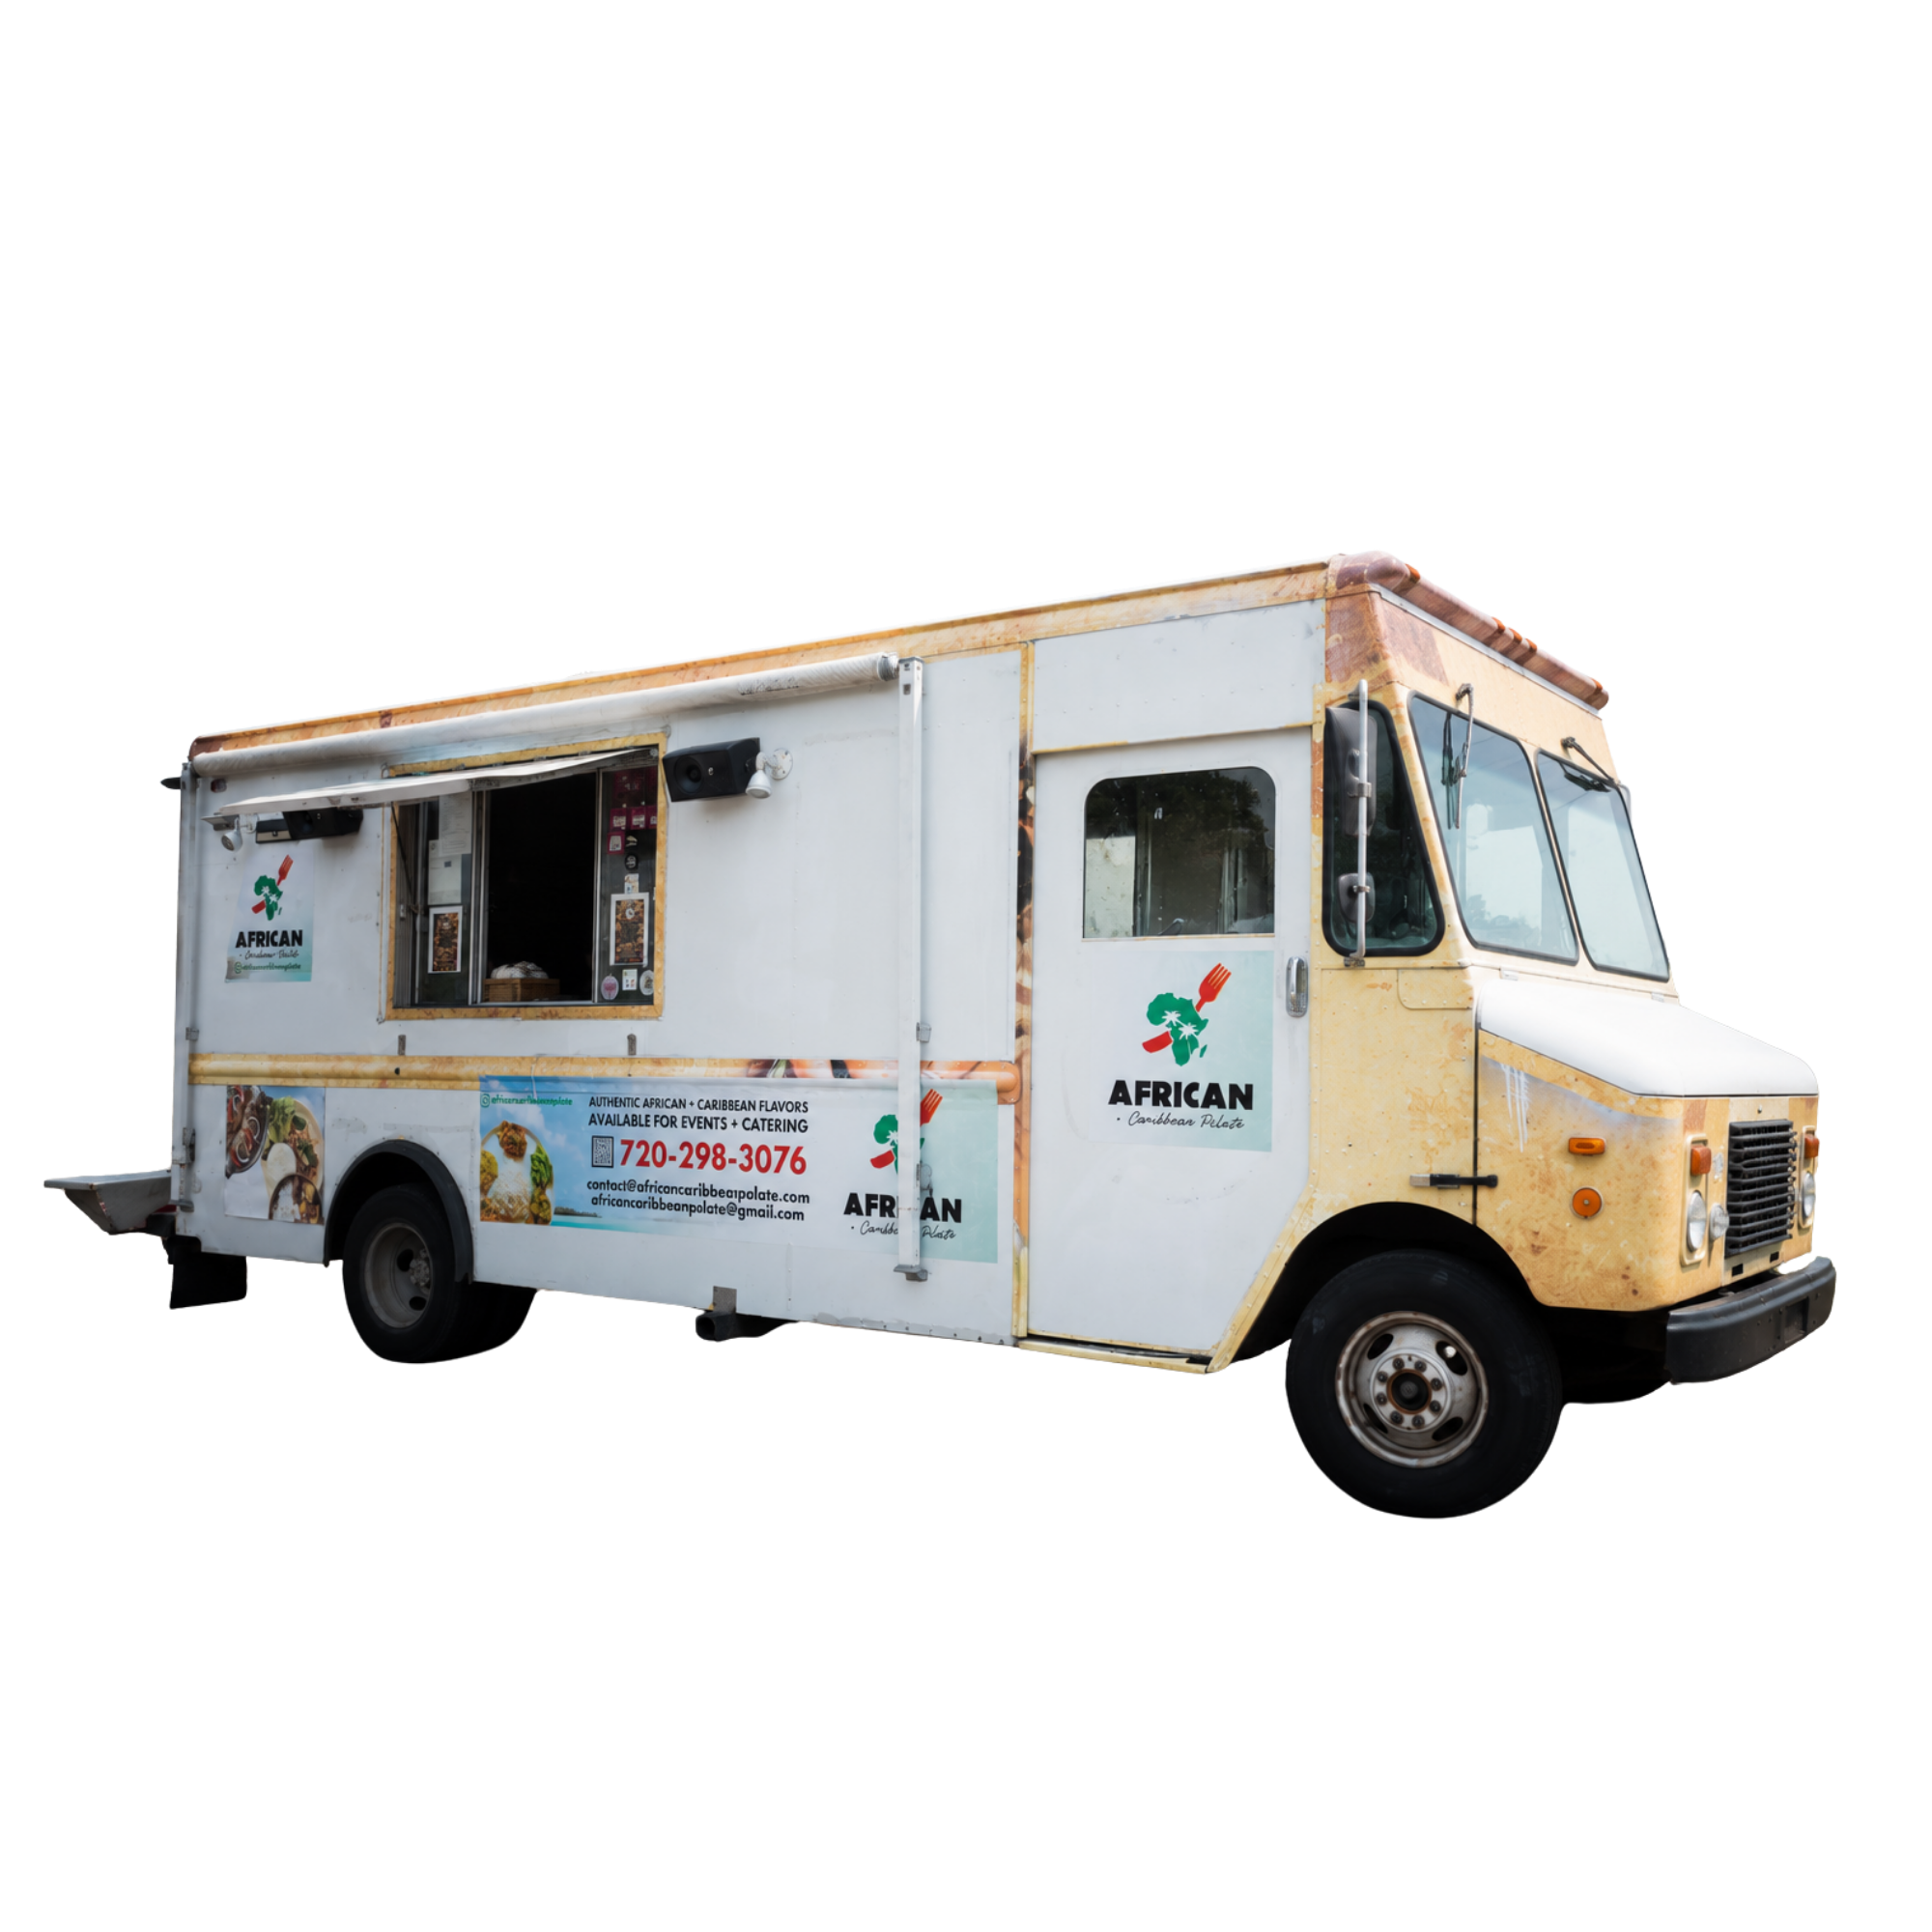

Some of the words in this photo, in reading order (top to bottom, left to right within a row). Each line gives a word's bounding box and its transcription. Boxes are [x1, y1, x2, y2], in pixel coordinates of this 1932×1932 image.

[235, 929, 303, 949] AFRICAN
[588, 1096, 640, 1109] AUTHENTIC
[642, 1097, 687, 1110] AFRICAN
[697, 1098, 757, 1112] CARIBBEAN
[759, 1100, 809, 1113] FLAVORS
[1108, 1080, 1253, 1110] AFRICAN
[588, 1113, 651, 1128] AVAILABLE
[653, 1115, 678, 1129] FOR
[681, 1116, 727, 1131] EVENTS
[731, 1119, 738, 1129] +
[742, 1118, 809, 1133] CATERING
[1128, 1111, 1196, 1126] Caribbean
[620, 1138, 807, 1175] 720-298-3076
[843, 1192, 962, 1223] AFRAN
